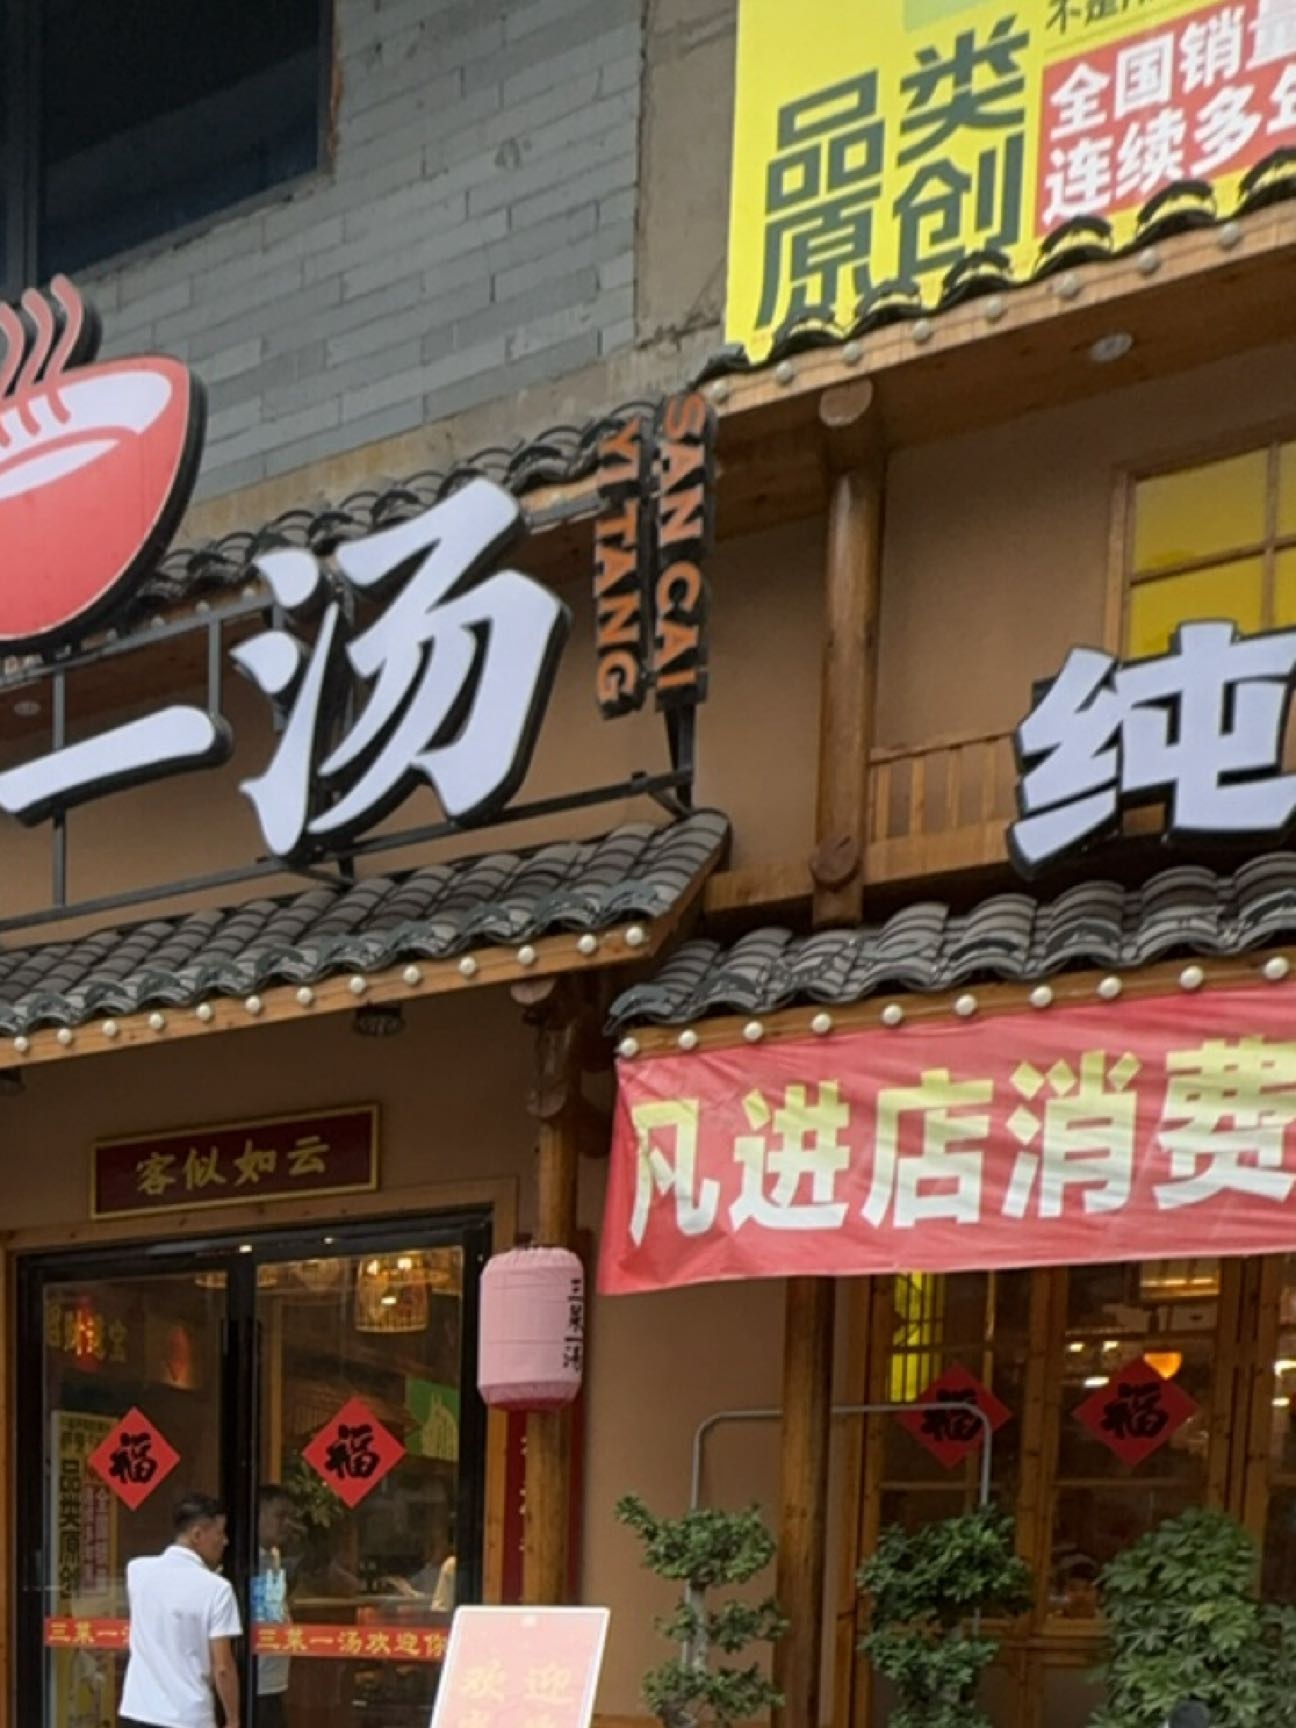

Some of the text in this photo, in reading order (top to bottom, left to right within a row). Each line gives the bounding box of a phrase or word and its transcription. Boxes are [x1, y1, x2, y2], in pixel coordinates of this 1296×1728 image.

[767, 14, 1030, 214] 品类
[755, 135, 1025, 331] 原创
[593, 416, 642, 702] YI TANG
[655, 392, 705, 689] SAN CAI
[1013, 620, 1296, 865] 纯
[628, 1036, 1296, 1248] 凡进店消费
[108, 1431, 159, 1484] 福
[324, 1422, 382, 1481] 福
